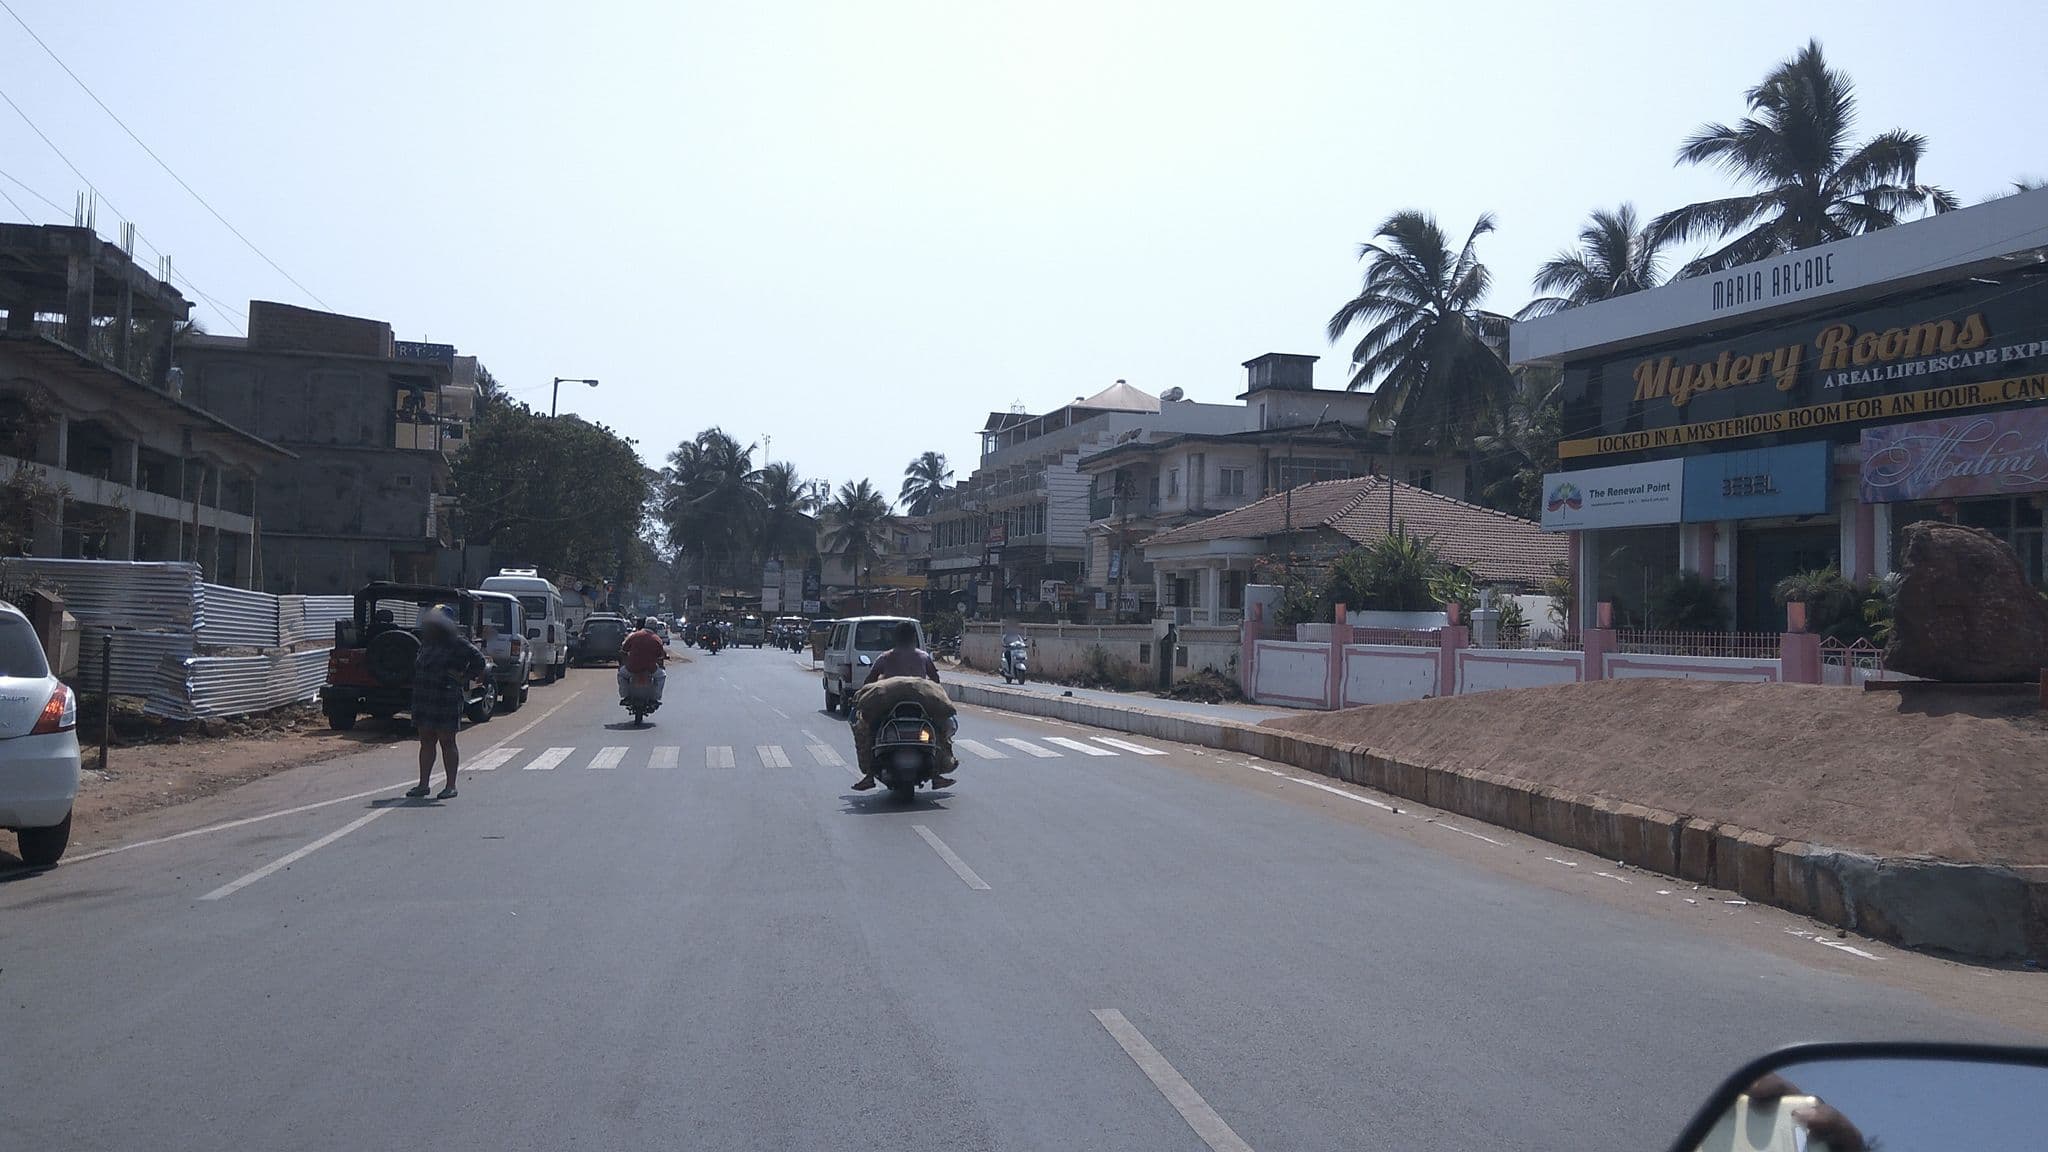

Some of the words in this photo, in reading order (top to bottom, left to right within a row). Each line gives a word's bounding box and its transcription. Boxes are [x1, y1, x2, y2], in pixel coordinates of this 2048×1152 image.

[1713, 270, 1762, 311] MARIA
[1772, 252, 1835, 297] ARCADE
[1632, 344, 1807, 407] Mystery
[1815, 312, 1991, 370] Rooms
[1823, 374, 1836, 389] A
[1837, 367, 1884, 387] REAL
[1886, 360, 1928, 380] LIFE
[1929, 349, 1999, 373] ESCAPE
[1597, 433, 1650, 453] LOCKED
[1655, 430, 1668, 446] IN
[1673, 428, 1682, 443] A
[1687, 413, 1782, 441] MYSTERIOUS
[1789, 404, 1841, 427] ROOM
[1846, 399, 1883, 421] FOR
[1892, 393, 1915, 414] AN
[2002, 375, 2046, 400] CAN
[1589, 488, 1605, 499] The
[1607, 484, 1645, 497] Renewal
[1646, 482, 1671, 493] Point
